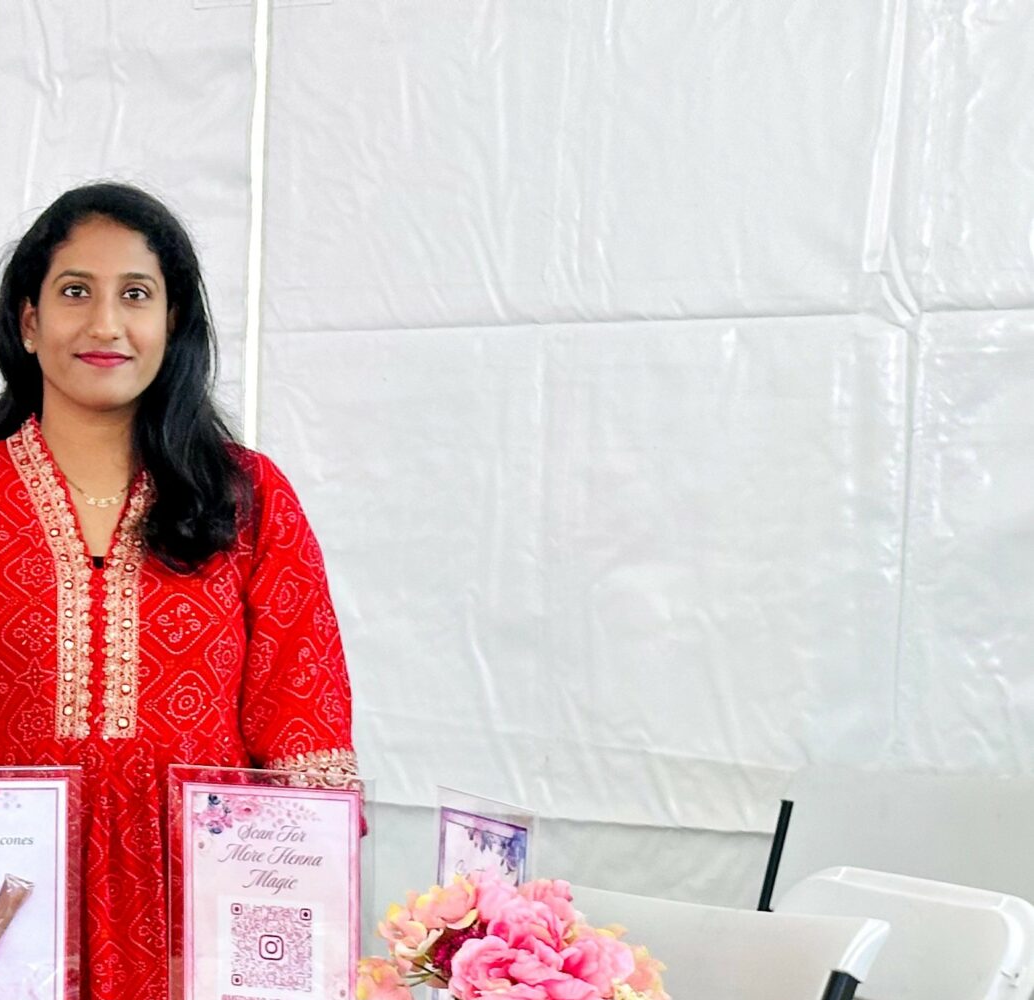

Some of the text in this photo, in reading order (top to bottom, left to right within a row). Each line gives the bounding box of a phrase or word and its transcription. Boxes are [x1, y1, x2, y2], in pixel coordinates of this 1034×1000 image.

[0, 836, 34, 847] cones
[237, 824, 306, 843] Scan For
[217, 843, 323, 867] More Henna
[242, 868, 298, 895] Magic
